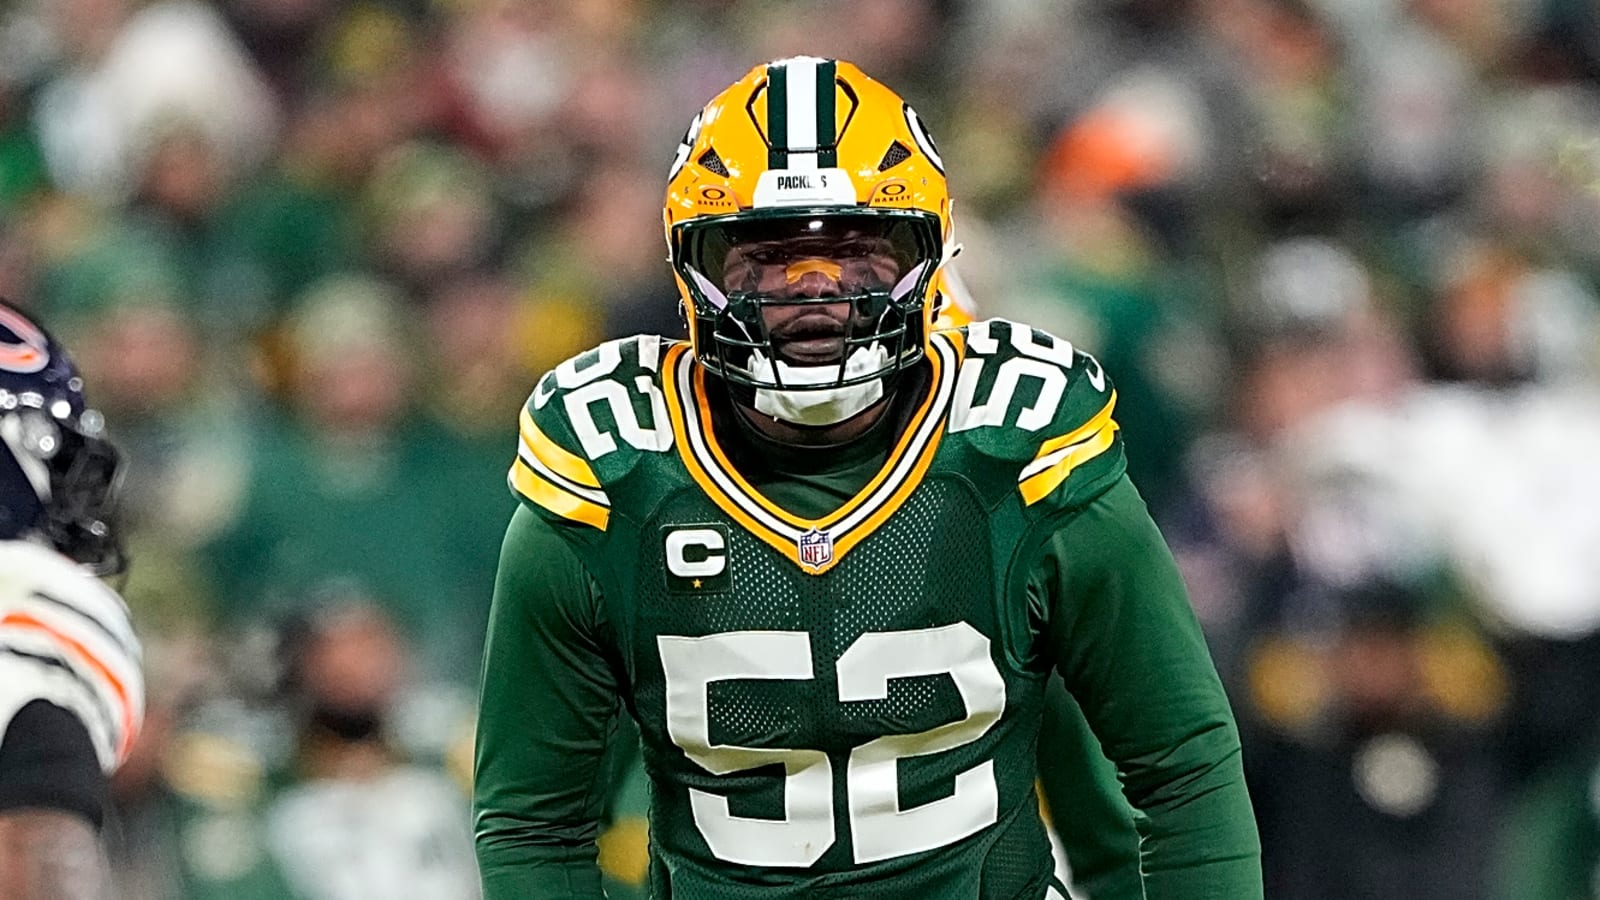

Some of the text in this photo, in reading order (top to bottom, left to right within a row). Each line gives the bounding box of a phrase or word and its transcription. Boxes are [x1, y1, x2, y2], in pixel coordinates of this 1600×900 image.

[555, 334, 674, 461] 52
[949, 317, 1073, 433] 52
[666, 529, 726, 577] C
[804, 545, 828, 562] NFL
[656, 621, 1006, 868] 52
